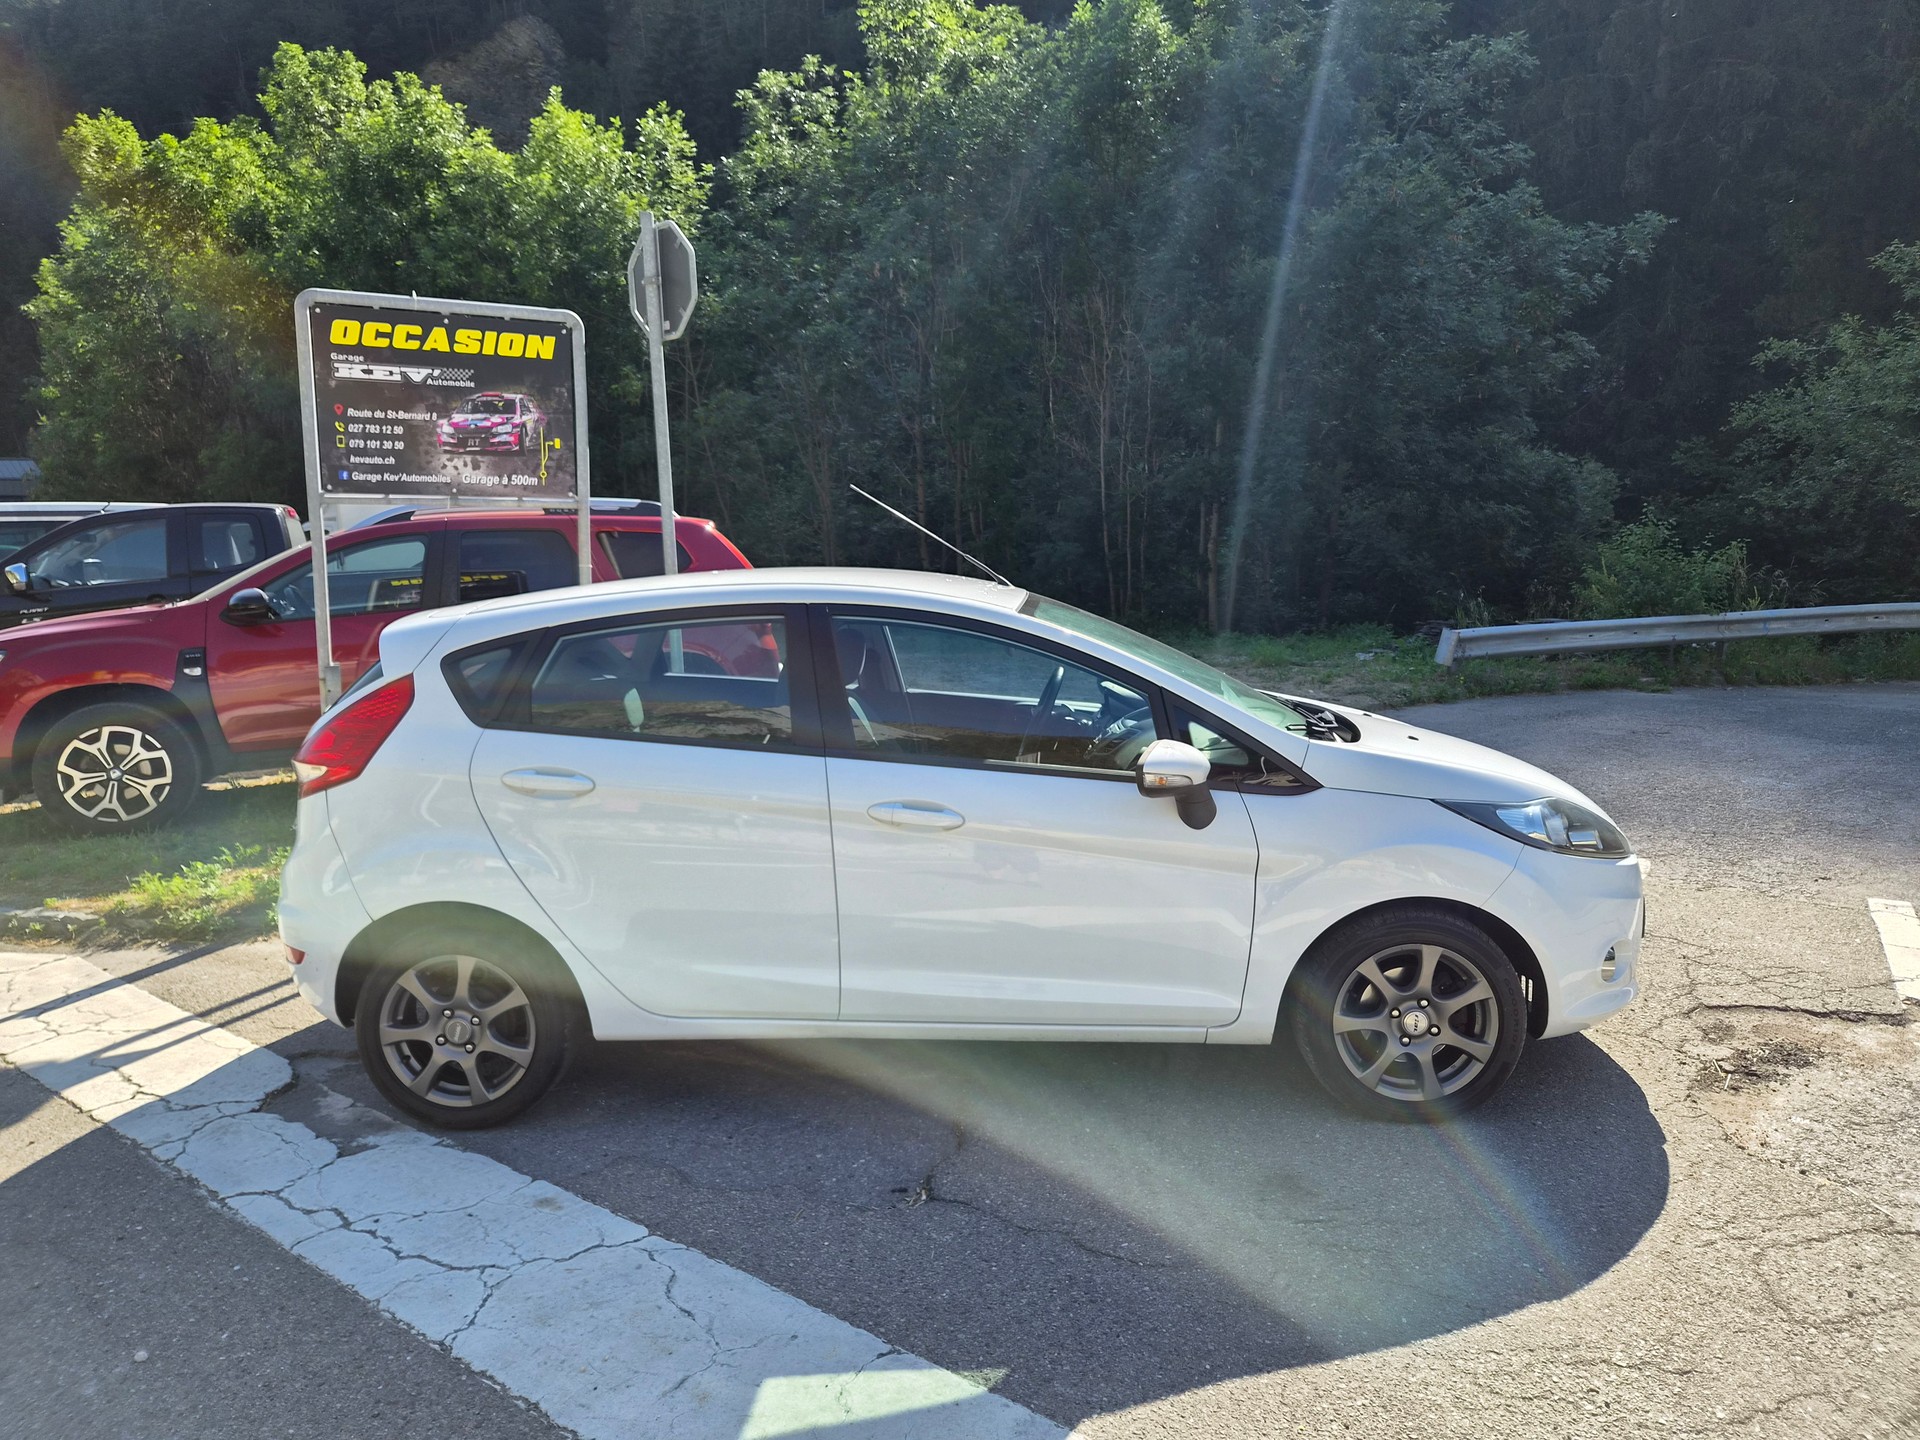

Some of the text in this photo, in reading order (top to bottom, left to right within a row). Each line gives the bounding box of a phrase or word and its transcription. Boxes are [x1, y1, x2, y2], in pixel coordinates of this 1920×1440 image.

[329, 319, 557, 360] OCCASION
[330, 352, 365, 362] Garage
[426, 378, 476, 388] Automobile
[347, 408, 438, 421] Route du St-Bernard 8
[348, 423, 363, 433] 027
[382, 425, 392, 434] 12
[393, 425, 404, 435] 50
[349, 439, 405, 450] 079 101 30 50
[350, 454, 395, 465] kevauto.ch
[351, 471, 452, 483] Garage Kev'Automobiles
[462, 474, 538, 486] Garage à 500m
